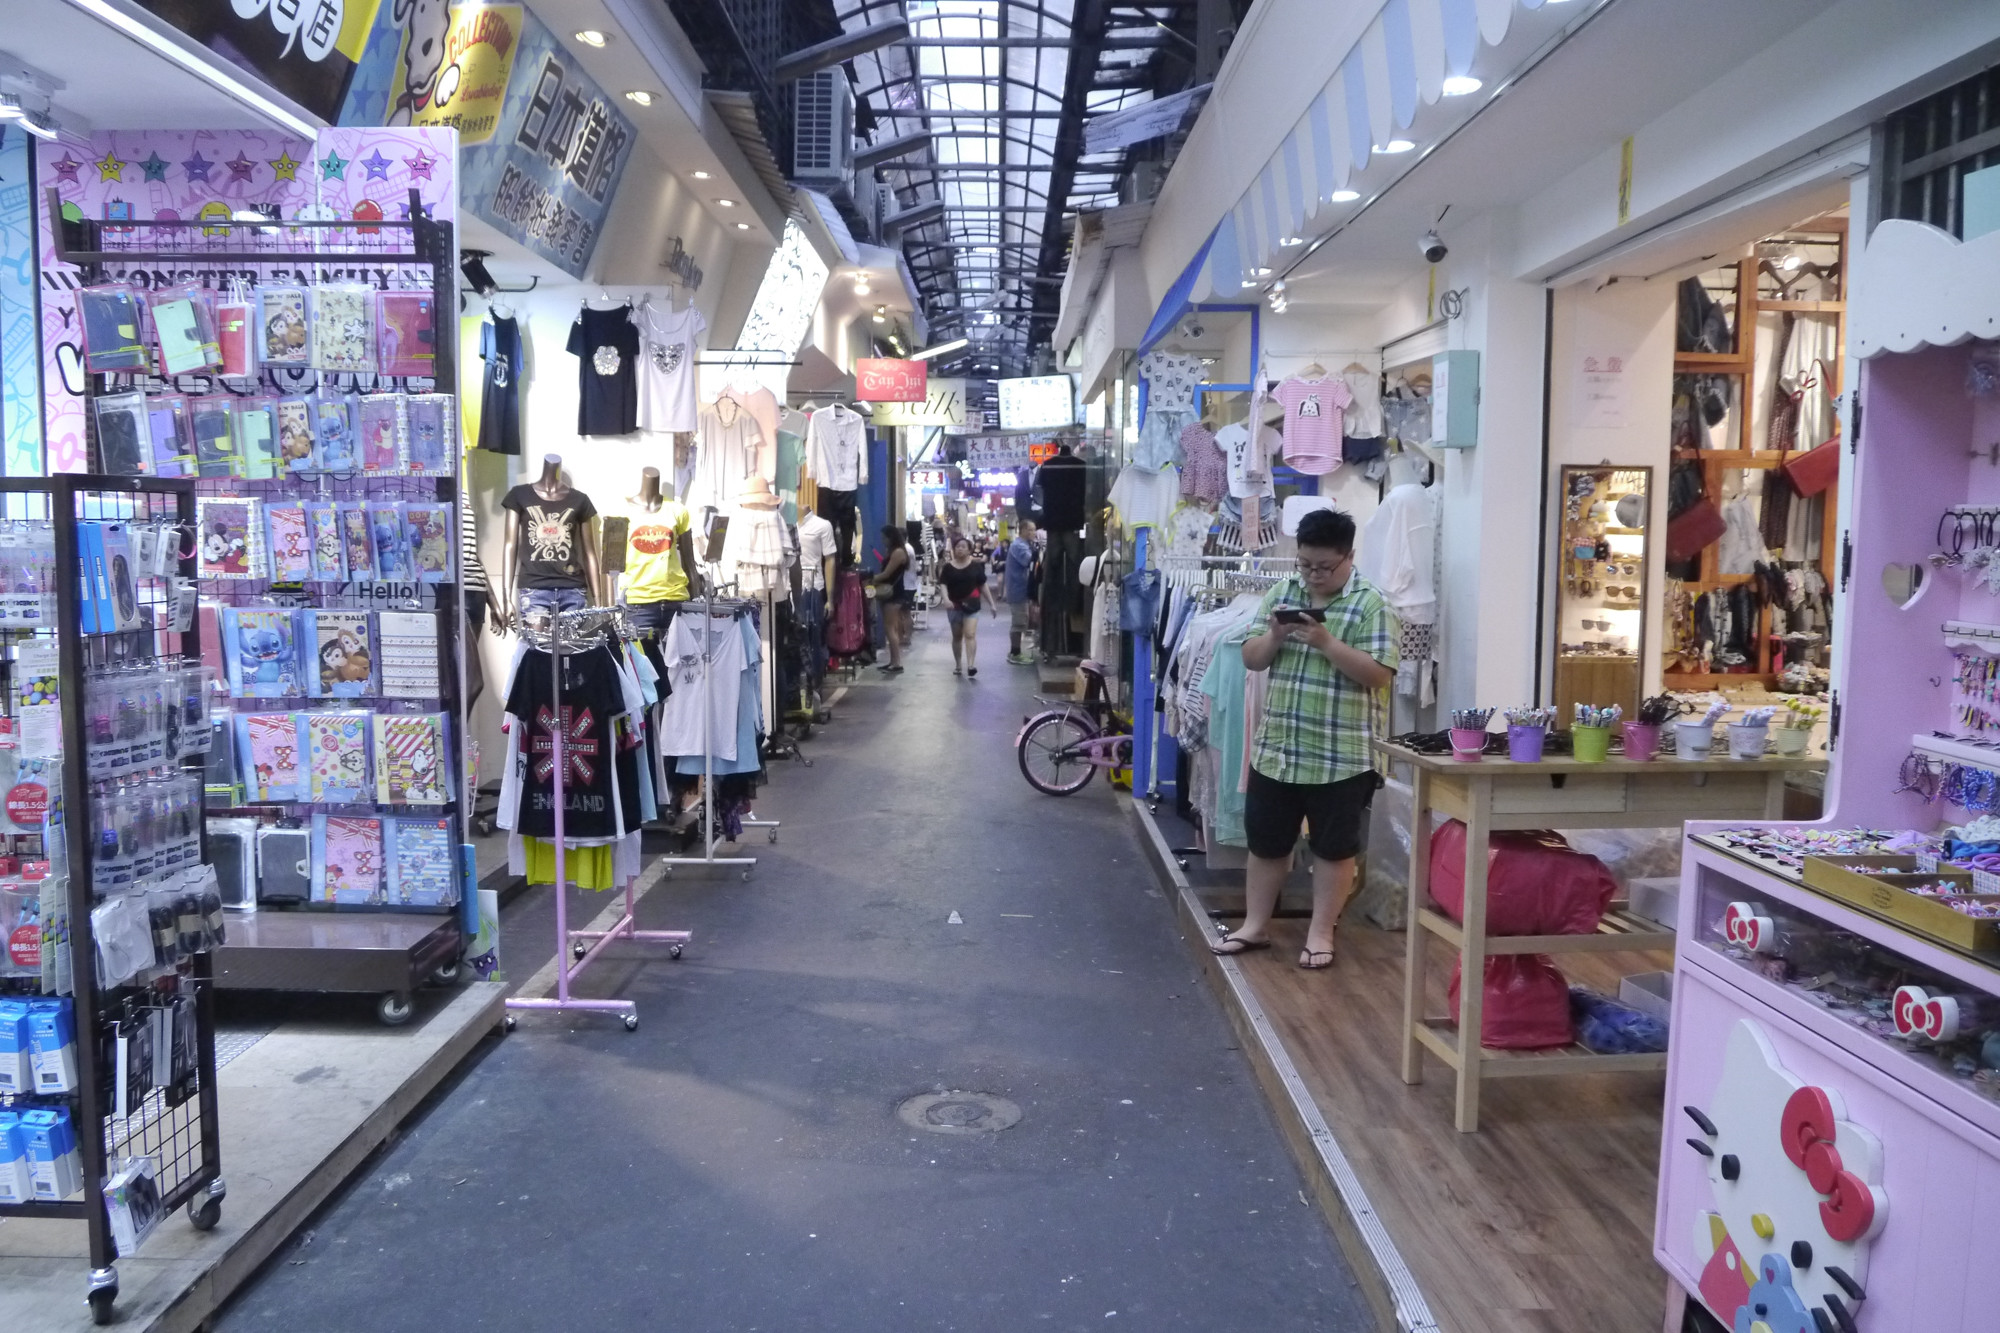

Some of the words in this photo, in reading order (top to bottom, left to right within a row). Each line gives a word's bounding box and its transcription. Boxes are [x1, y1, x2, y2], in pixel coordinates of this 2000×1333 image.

[516, 53, 627, 203] 日本道格
[492, 162, 593, 265] 服飾批發零售
[533, 793, 605, 812] ENLAND
